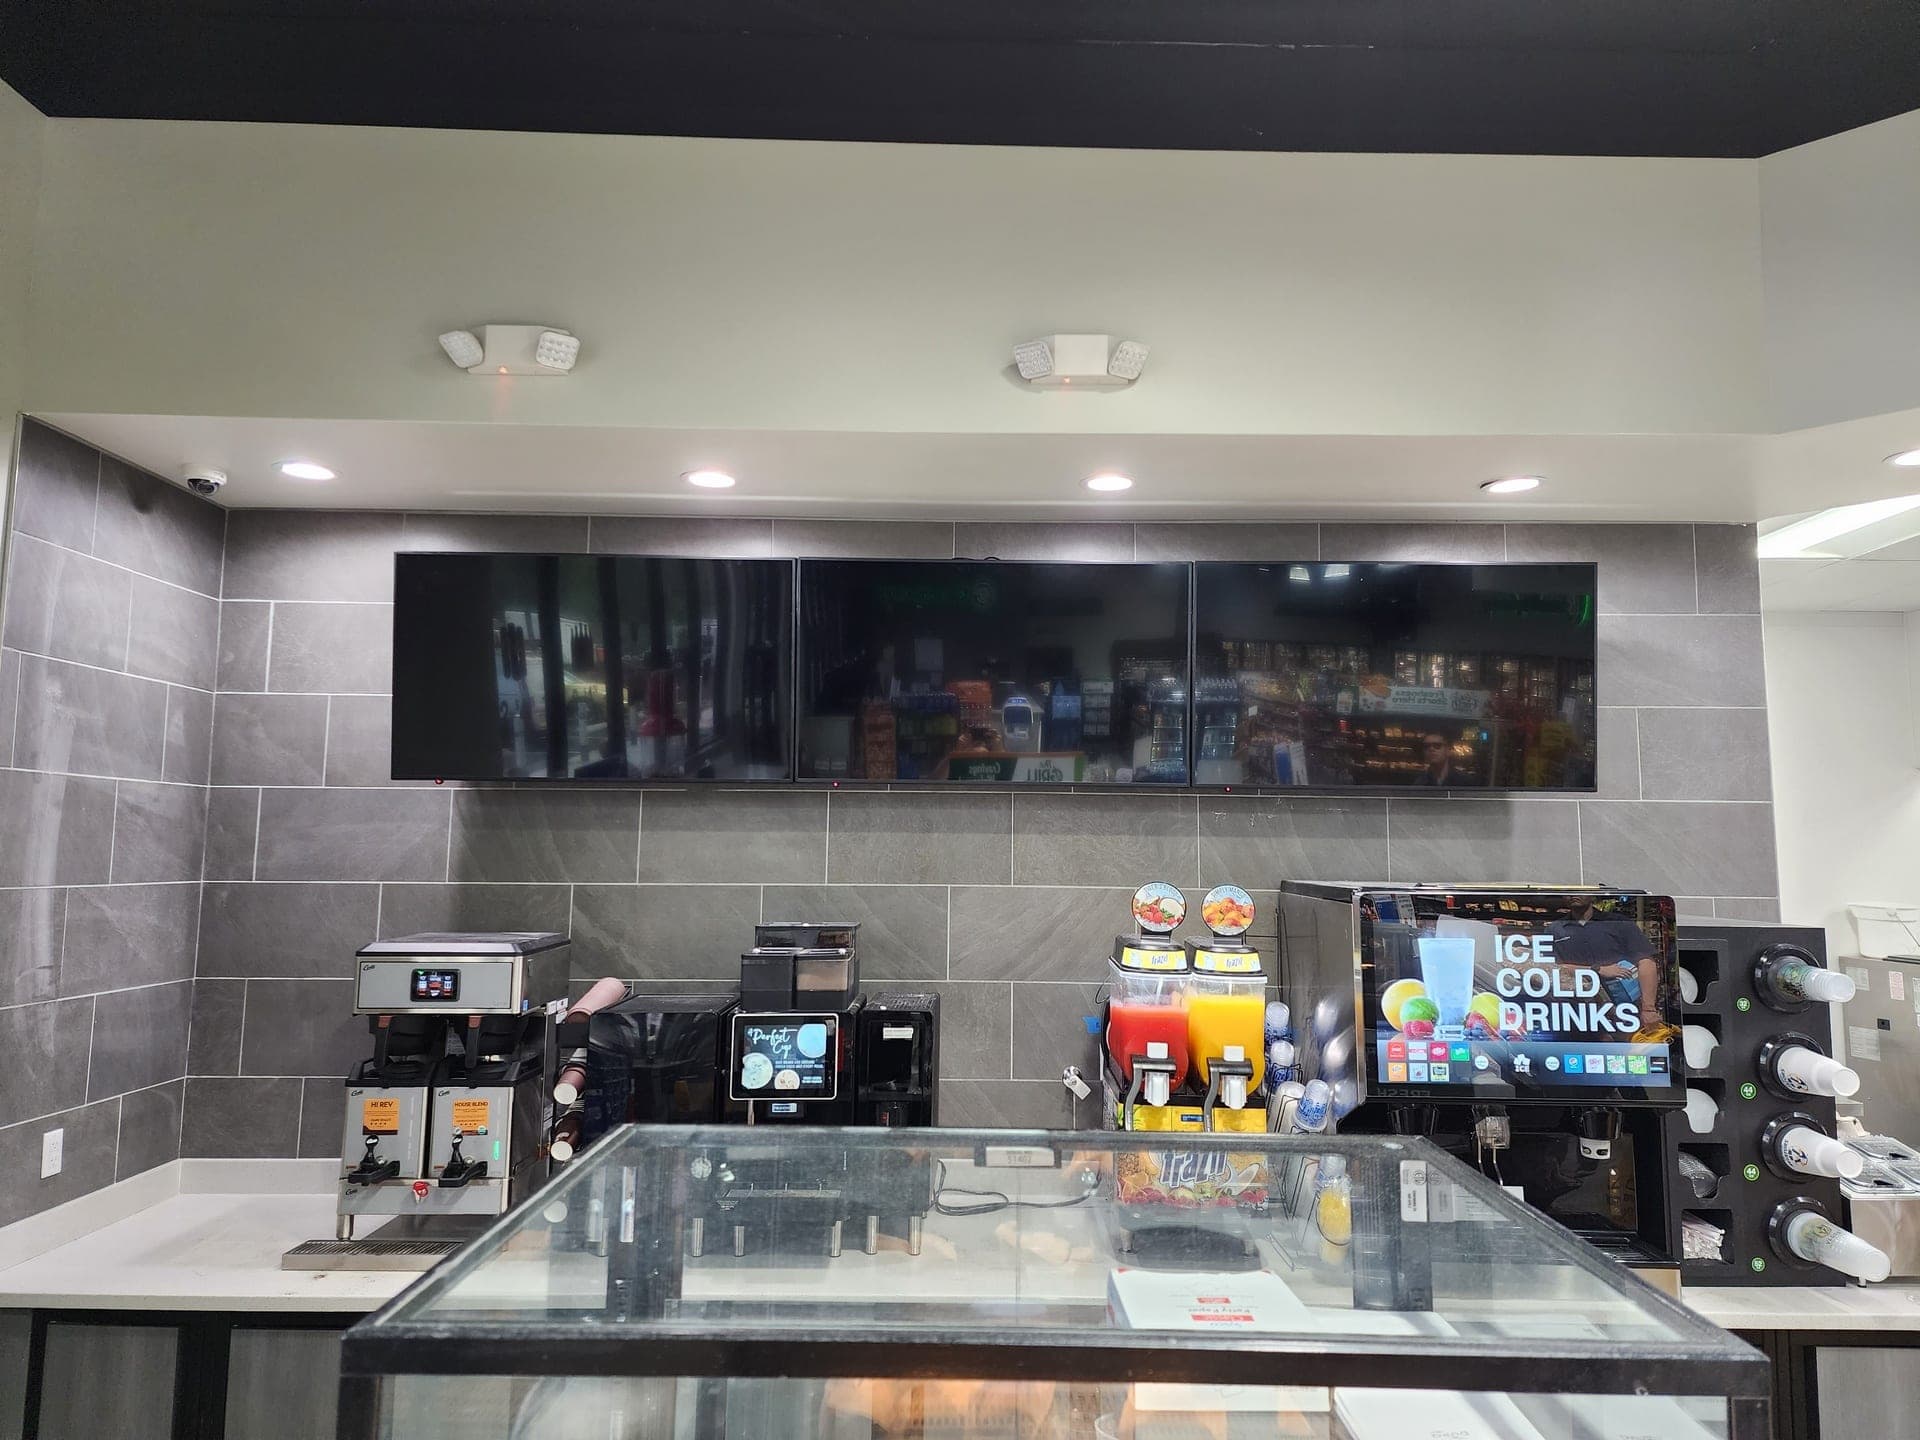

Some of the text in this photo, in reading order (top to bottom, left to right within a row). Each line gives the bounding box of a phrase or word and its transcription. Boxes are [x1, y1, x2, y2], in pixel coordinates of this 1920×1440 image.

[1494, 934, 1556, 964] ICE
[1496, 968, 1601, 998] COLD
[1499, 1002, 1641, 1034] DRINKS
